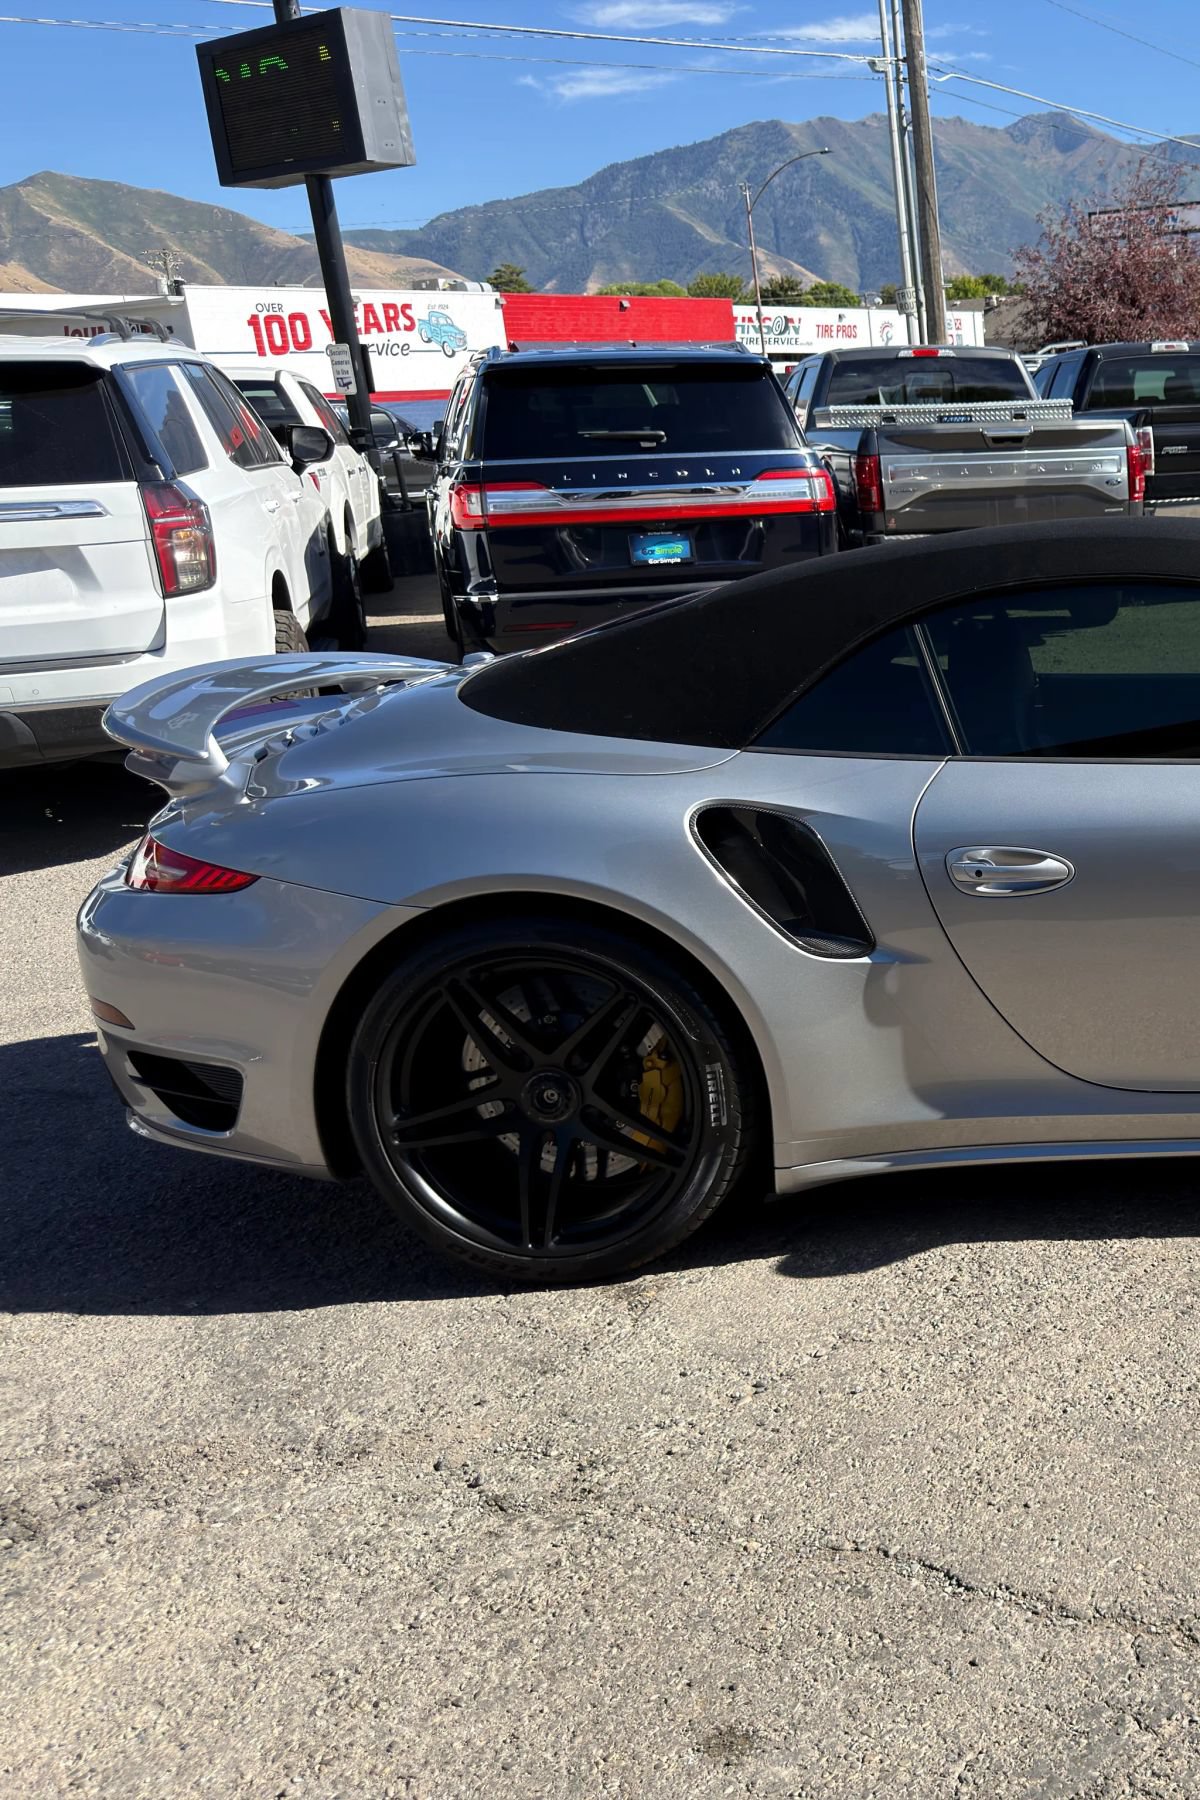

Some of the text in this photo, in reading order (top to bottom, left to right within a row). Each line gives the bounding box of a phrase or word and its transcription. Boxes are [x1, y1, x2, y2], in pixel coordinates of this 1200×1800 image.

[255, 303, 284, 313] OVER
[247, 312, 313, 357] 100
[816, 324, 857, 339] TIRE PROS
[563, 467, 741, 481] LINCOLN
